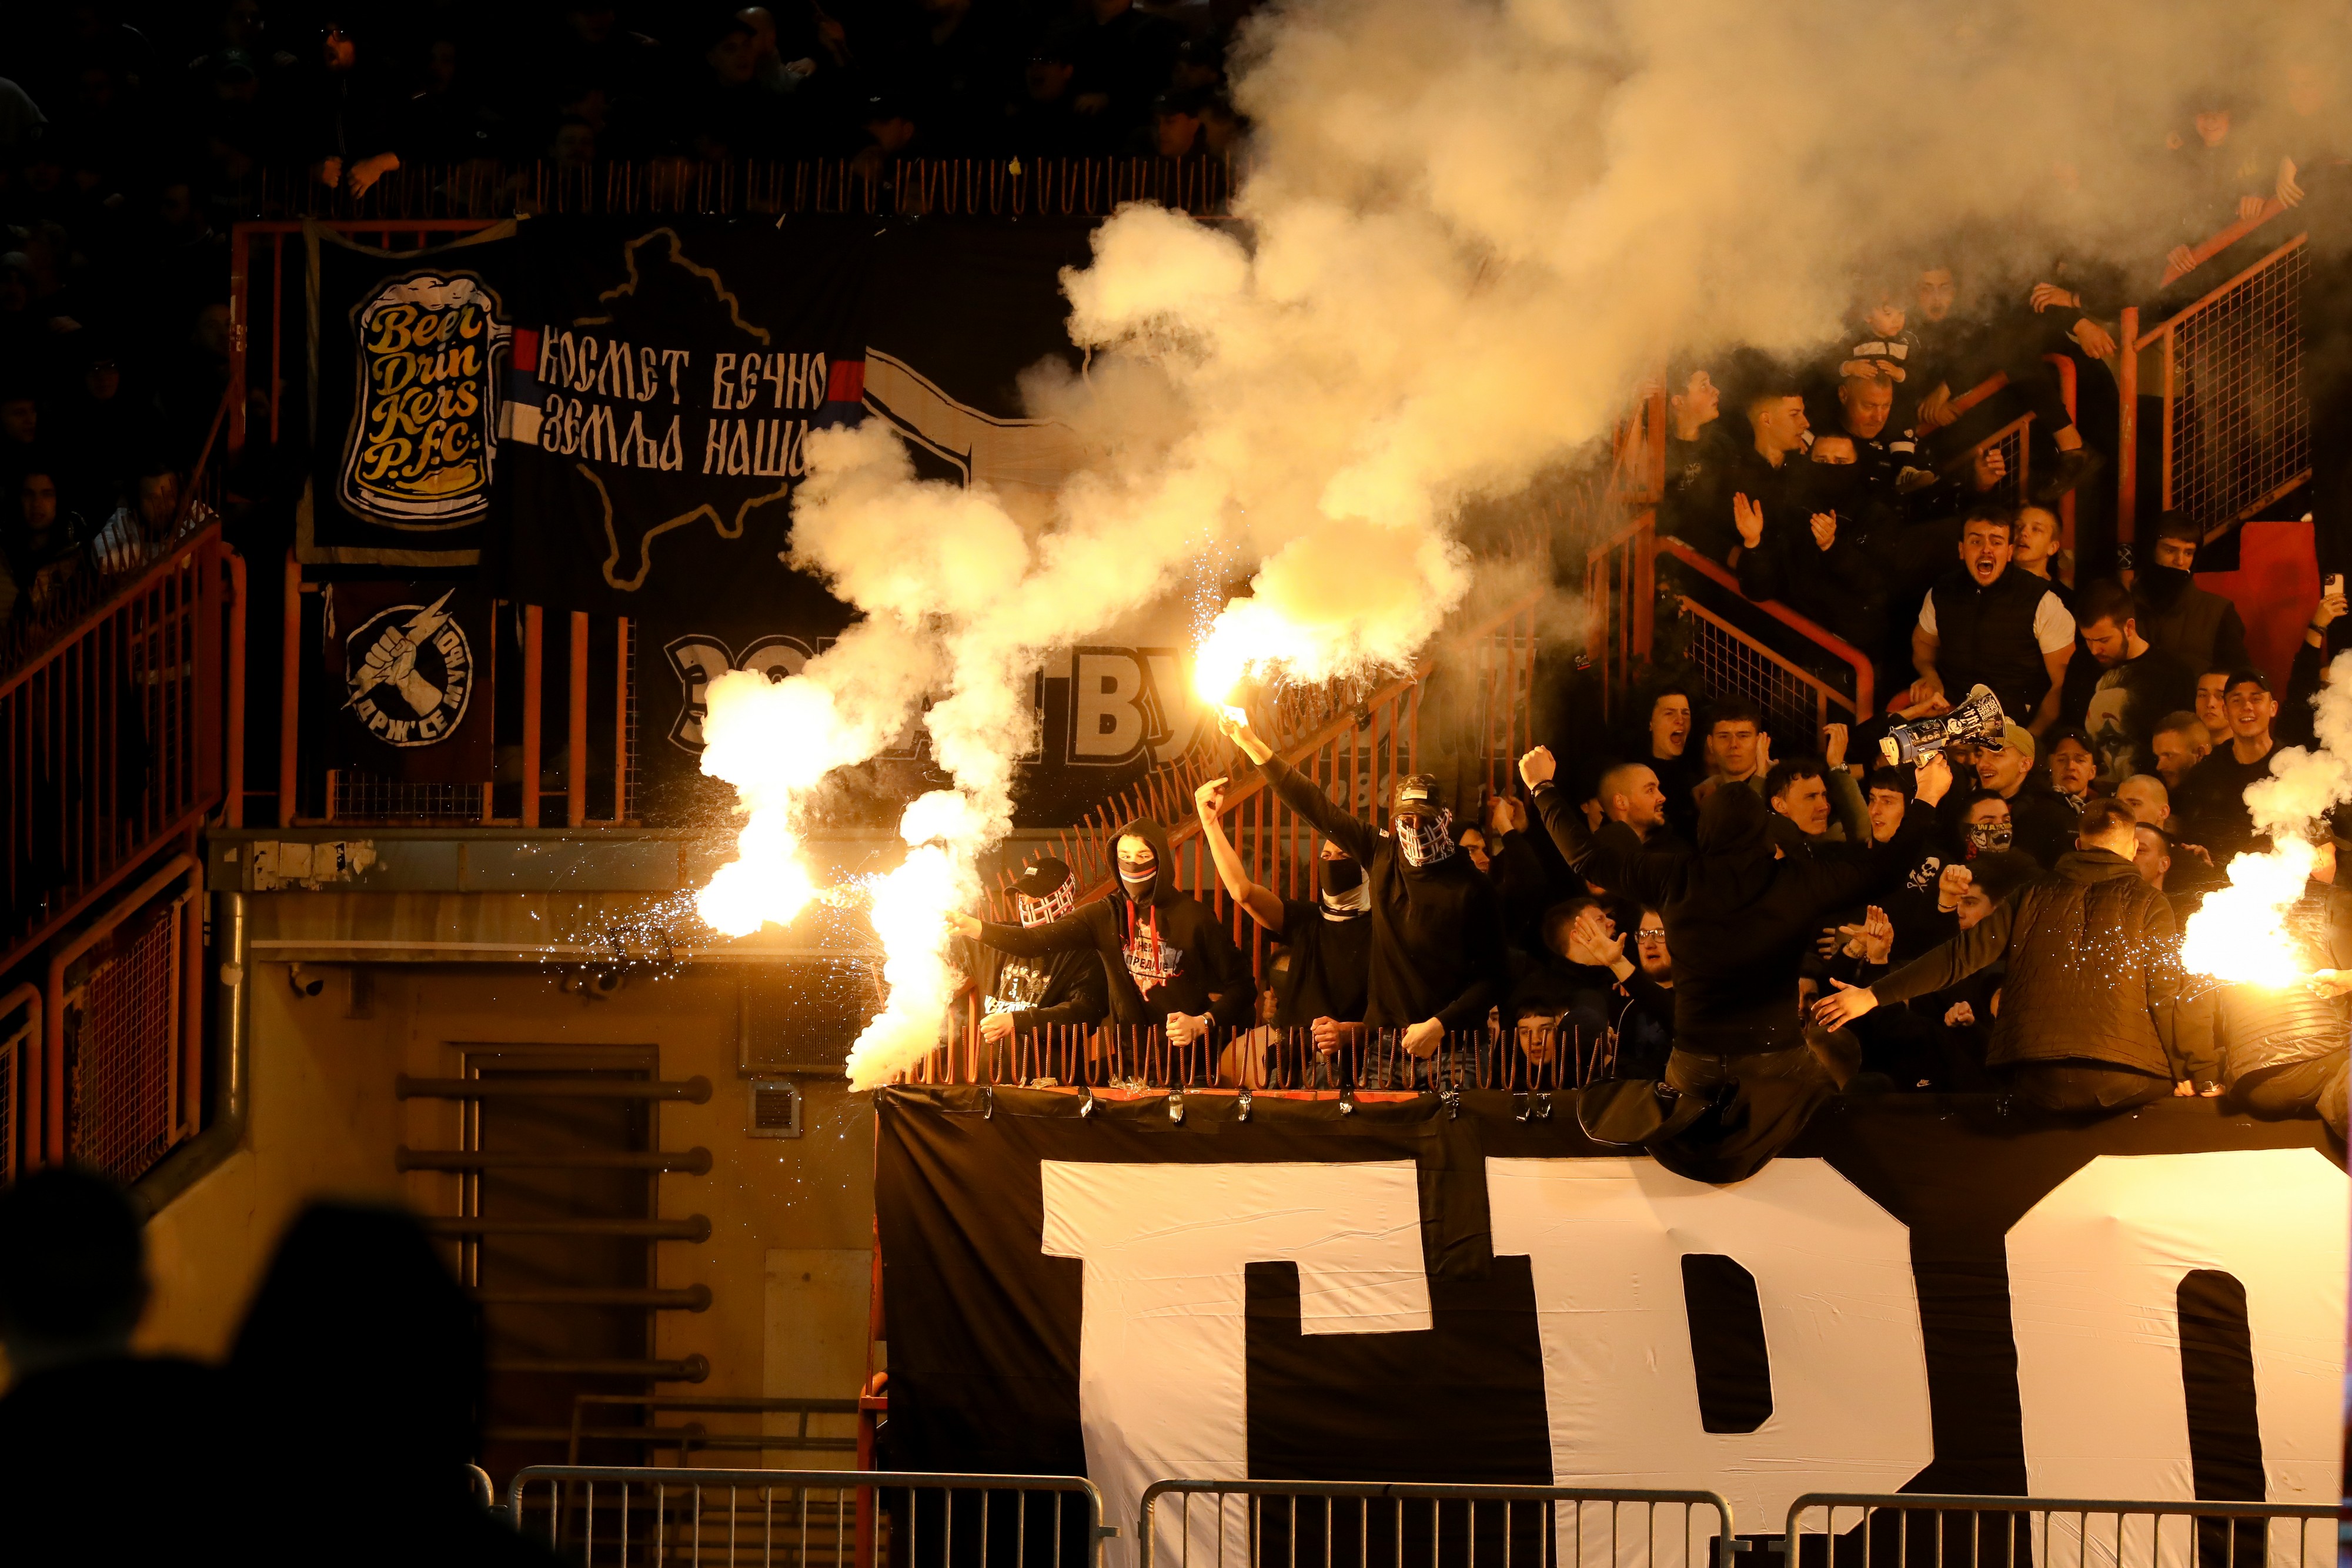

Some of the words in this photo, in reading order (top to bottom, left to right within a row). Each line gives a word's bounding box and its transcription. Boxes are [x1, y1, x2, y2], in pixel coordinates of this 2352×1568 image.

[368, 303, 482, 354] Beer
[372, 343, 482, 396] Drin
[537, 325, 690, 404] КОСМЕТ
[713, 352, 827, 410] ВЕЧНО
[543, 393, 683, 472] ЗЕМЉА
[702, 419, 811, 477] НАША
[419, 709, 448, 739] СЕ
